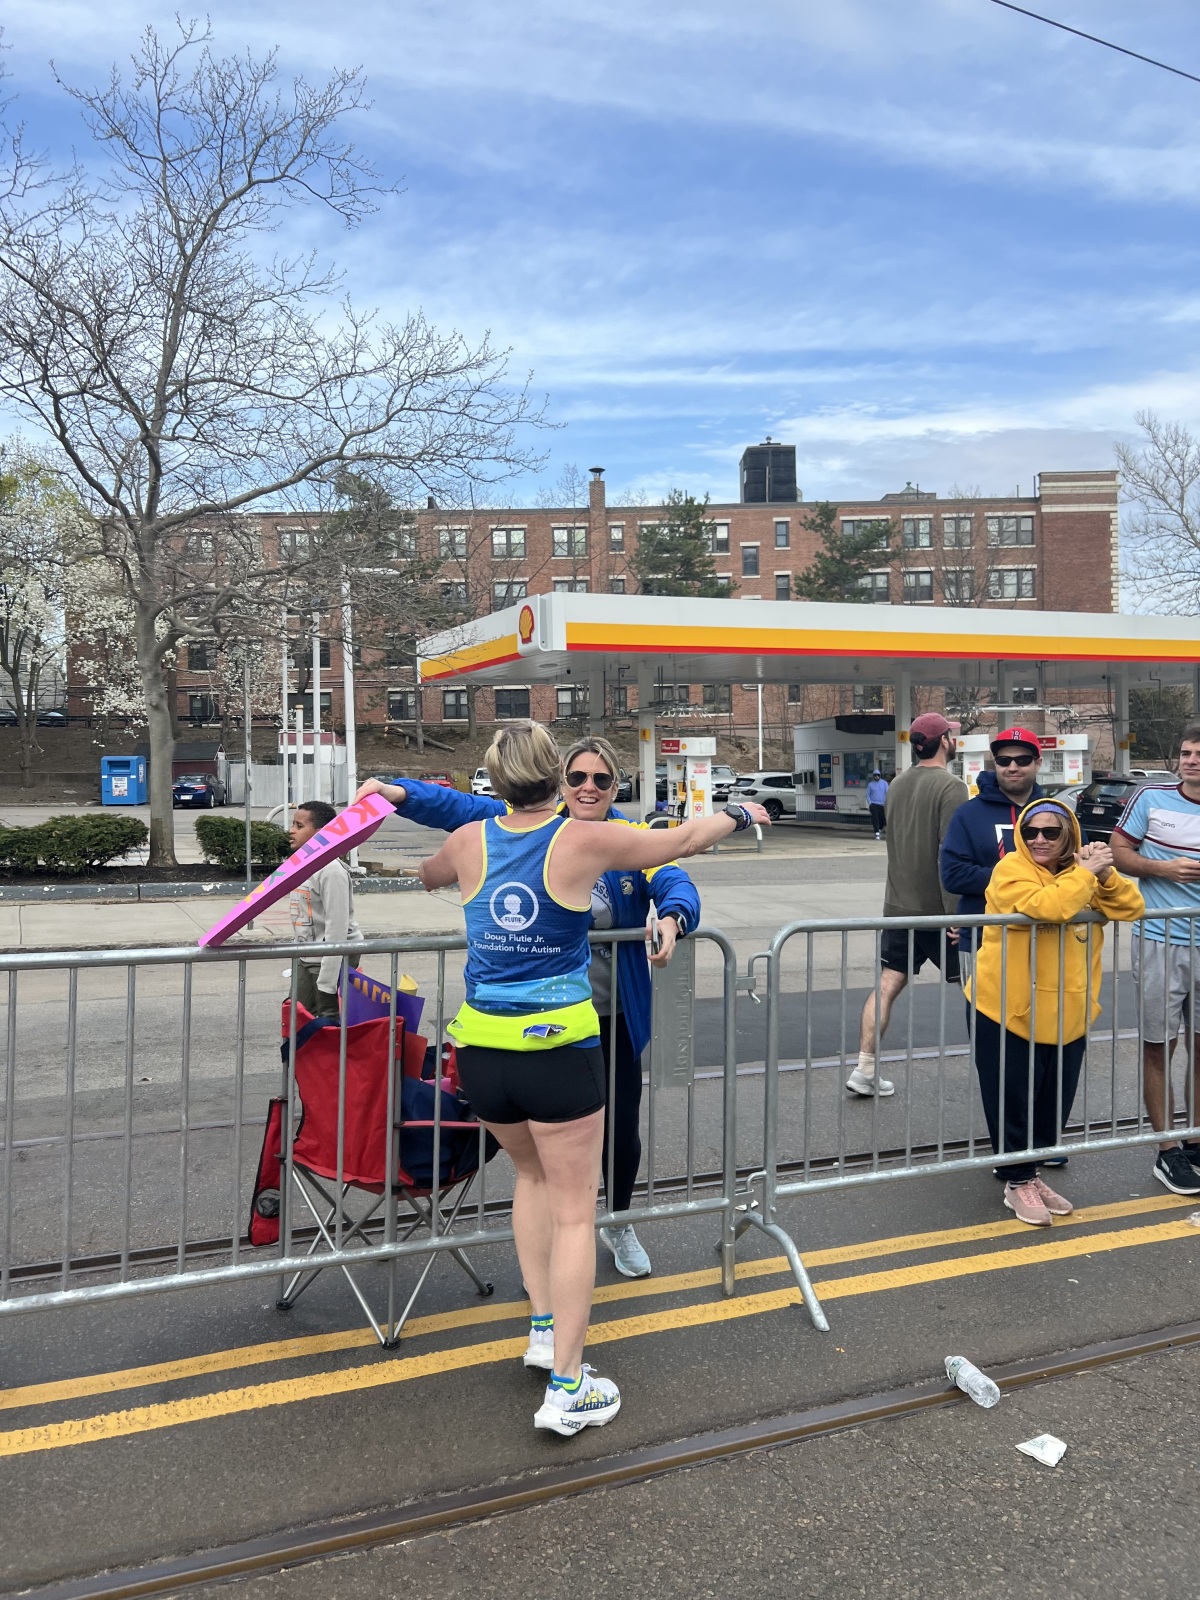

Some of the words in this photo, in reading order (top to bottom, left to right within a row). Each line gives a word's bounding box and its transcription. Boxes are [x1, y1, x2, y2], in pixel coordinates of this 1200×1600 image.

[1011, 730, 1021, 741] B
[484, 932, 507, 943] Doug
[508, 933, 533, 943] Flutie
[533, 935, 545, 943] Jr.
[473, 940, 514, 952] Foundation
[516, 944, 529, 953] for
[530, 945, 561, 954] Autism
